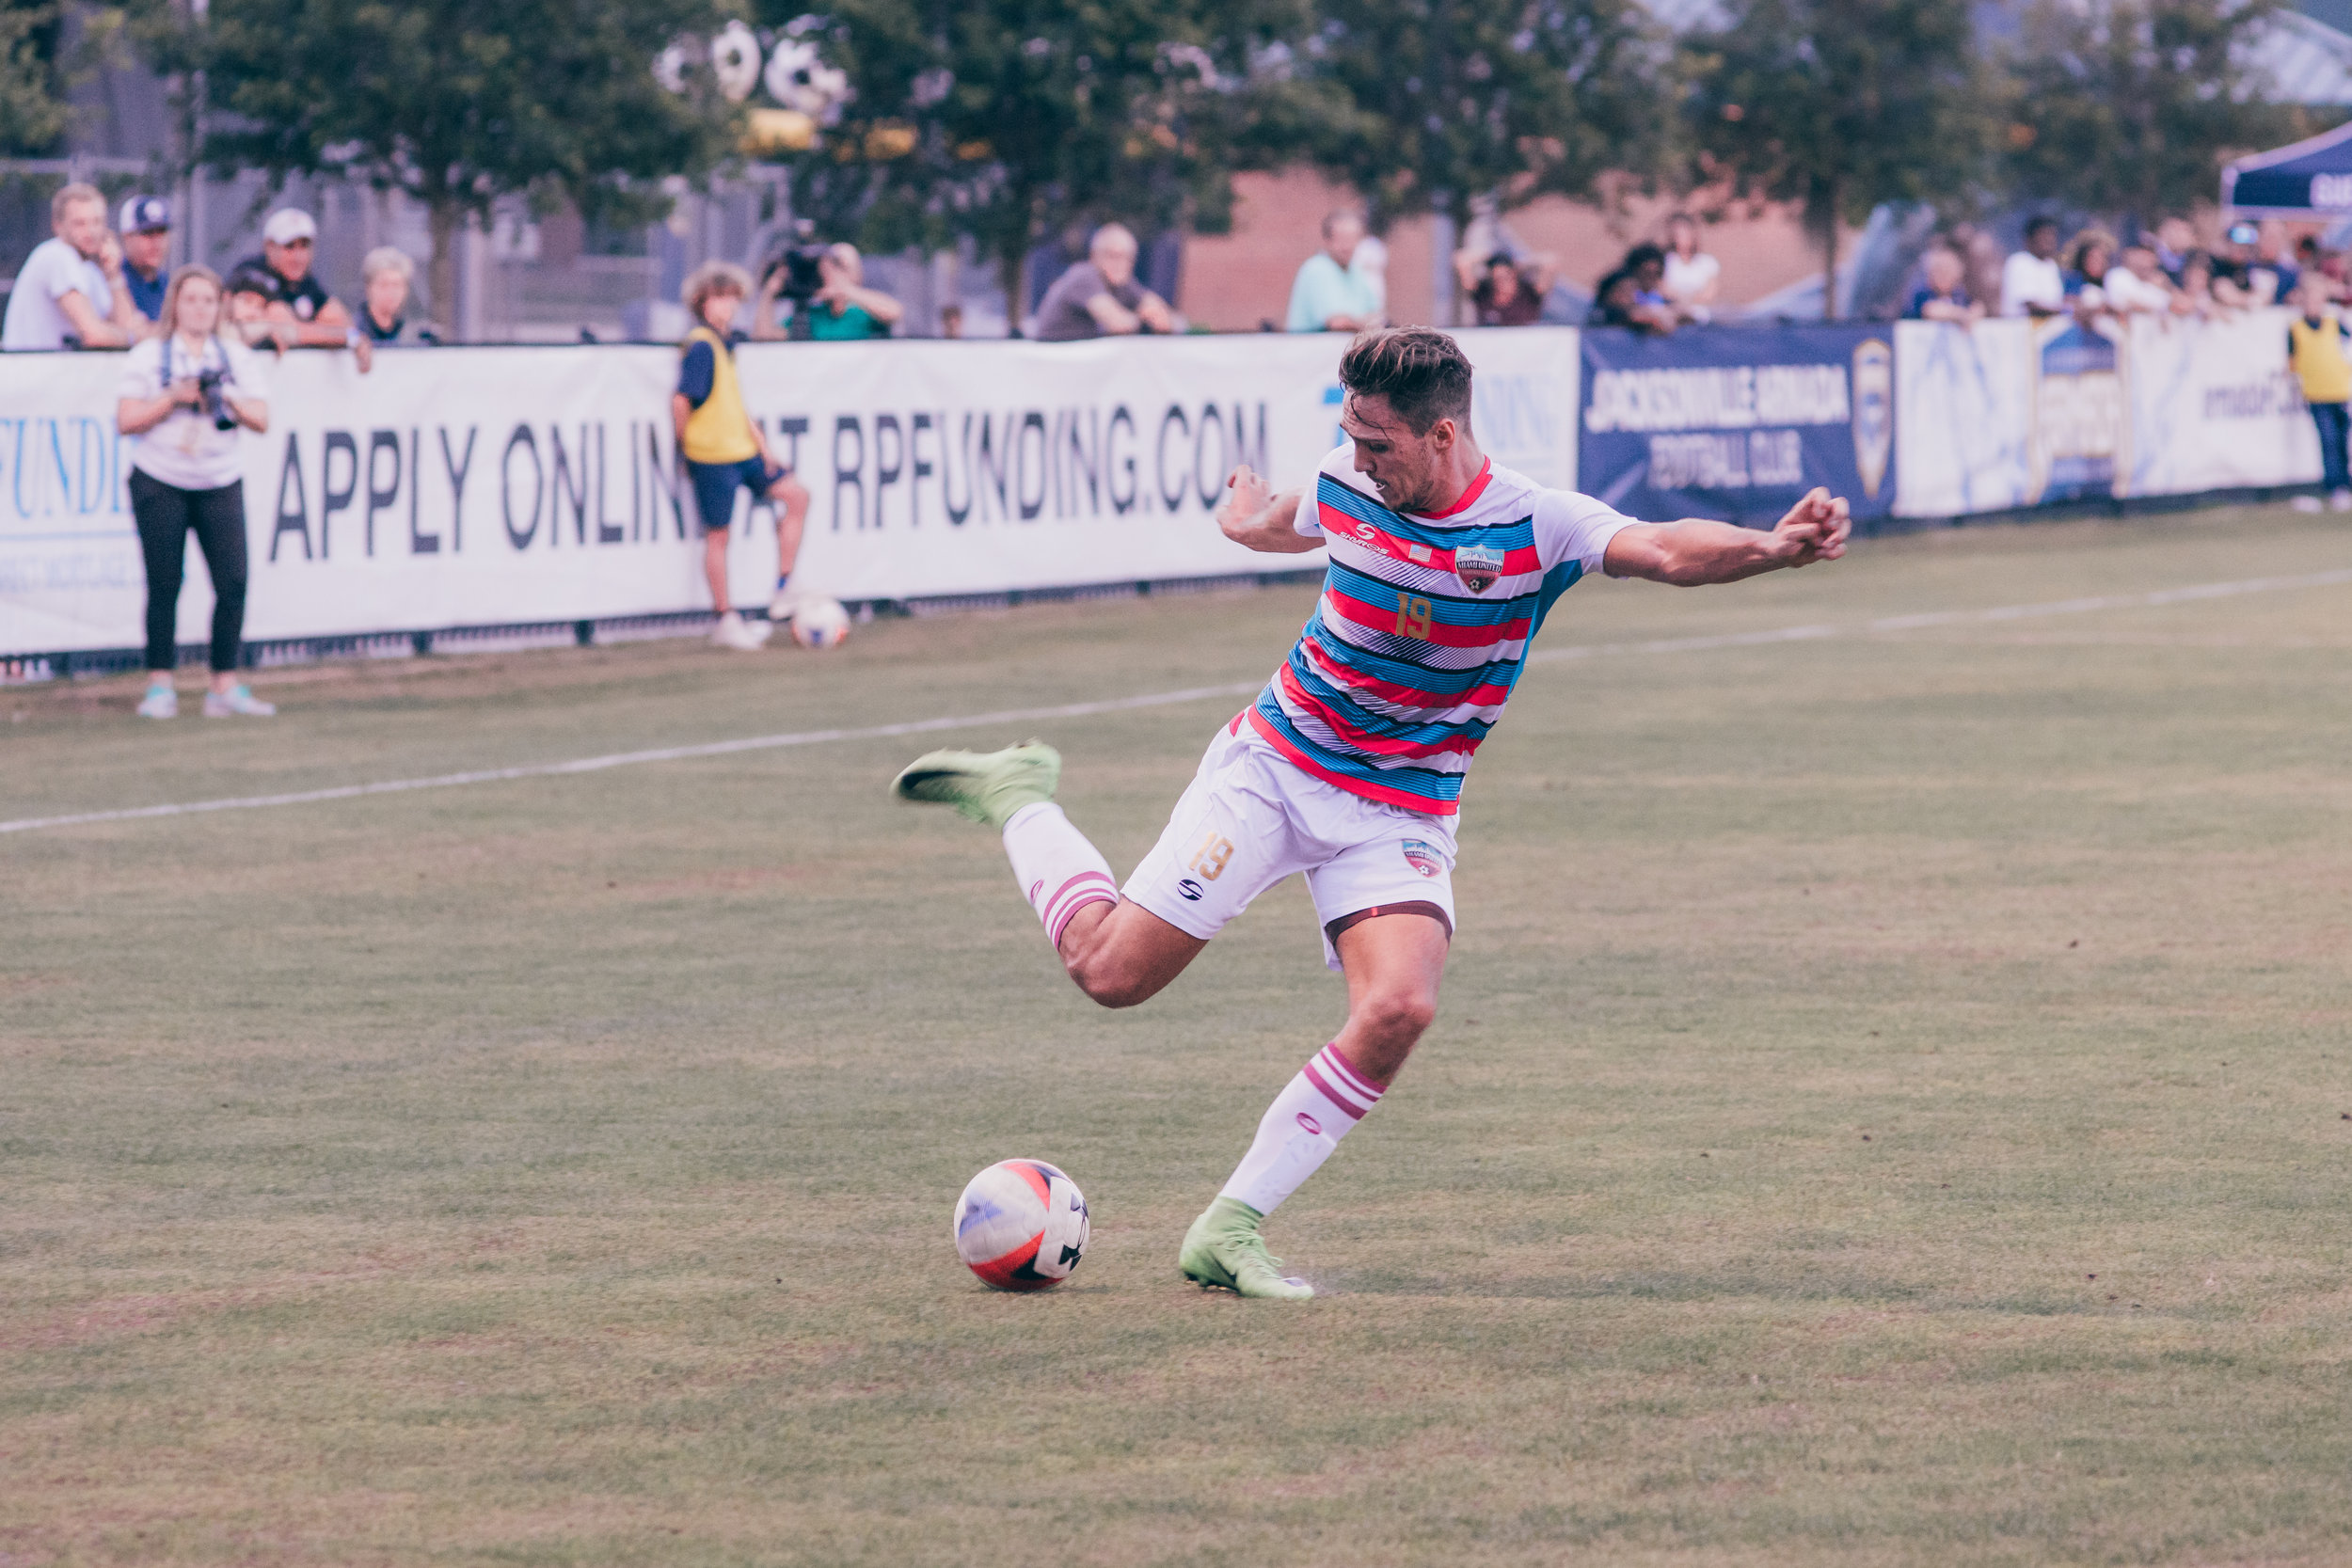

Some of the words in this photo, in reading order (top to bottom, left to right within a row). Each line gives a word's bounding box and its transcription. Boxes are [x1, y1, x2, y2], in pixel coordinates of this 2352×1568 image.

[269, 425, 476, 562] APPLY
[501, 422, 706, 551] ONLIN
[831, 402, 1269, 531] RPFUNDING.COM
[1395, 592, 1432, 641] 19
[1188, 831, 1234, 881] 19
